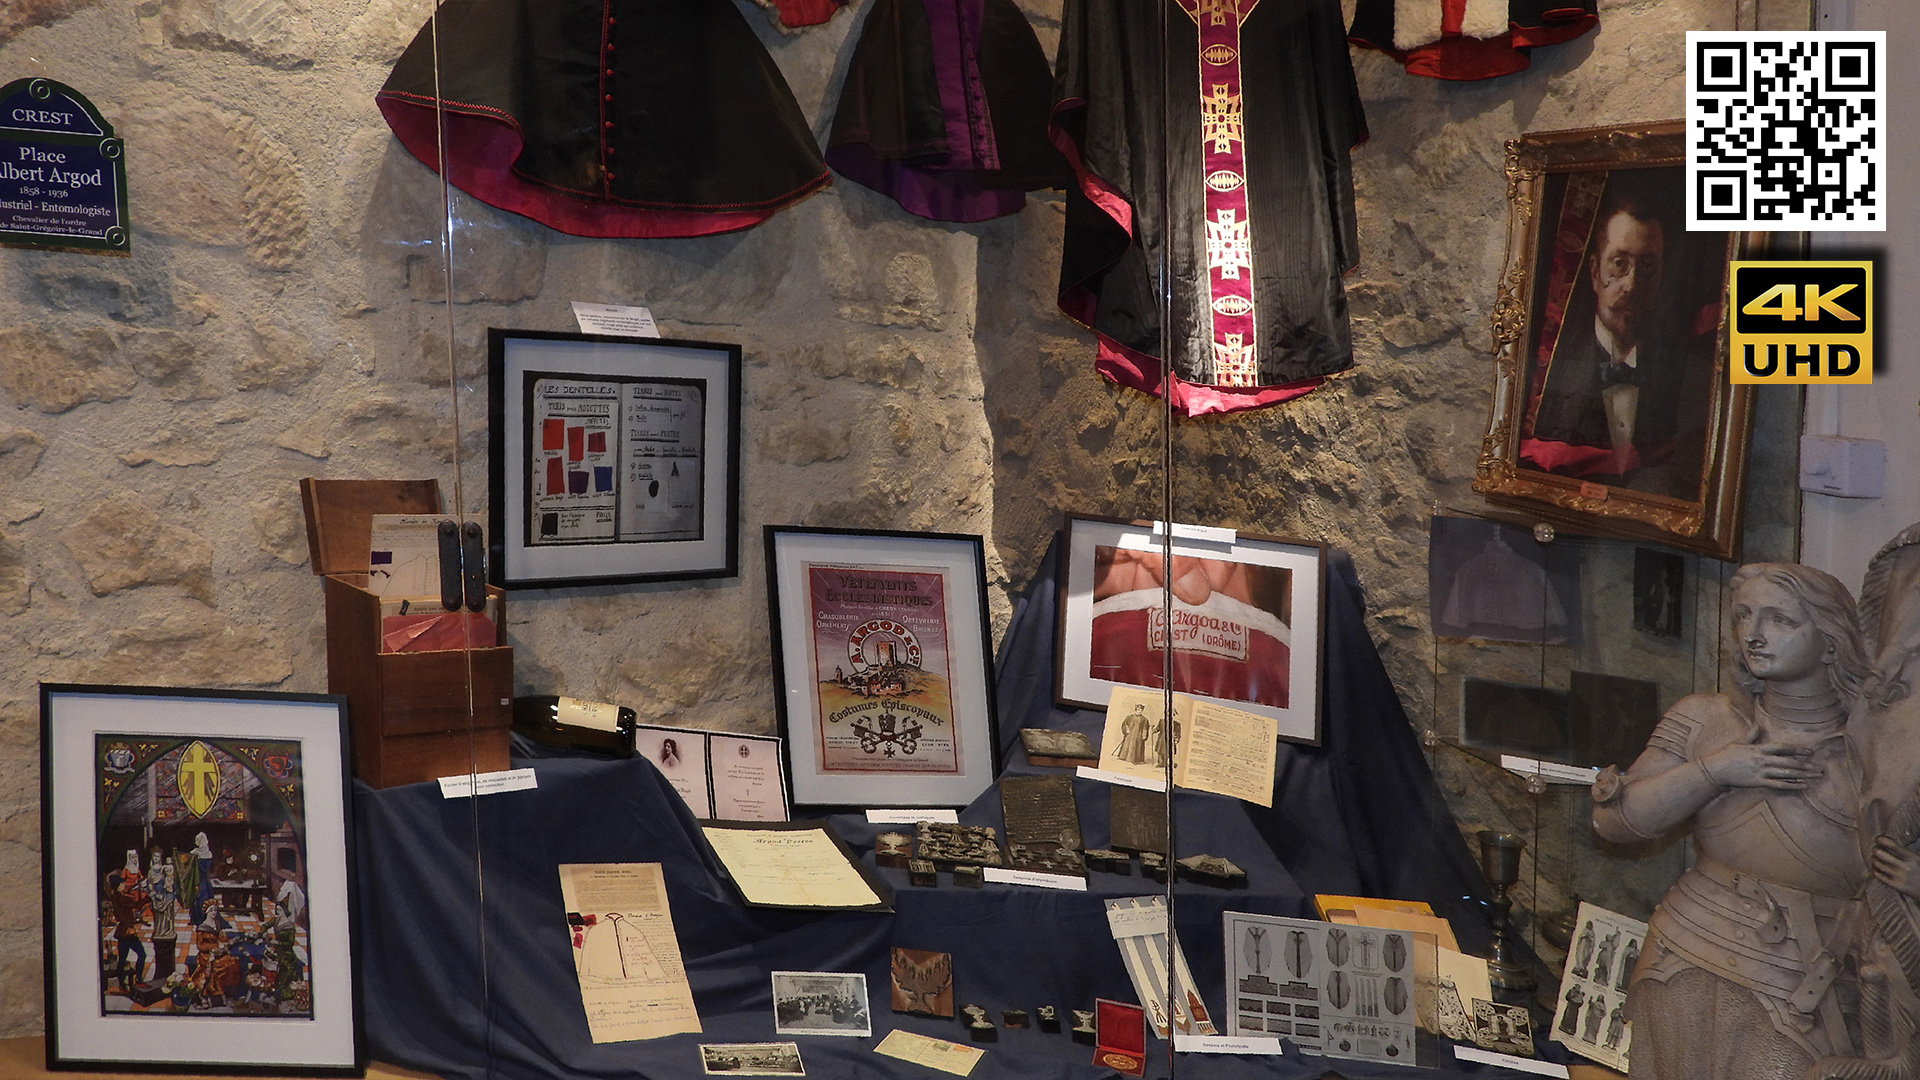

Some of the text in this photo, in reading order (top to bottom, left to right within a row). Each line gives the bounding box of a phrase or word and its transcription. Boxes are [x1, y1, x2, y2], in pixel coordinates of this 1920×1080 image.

[12, 108, 73, 125] CREST
[19, 147, 66, 164] Place
[49, 167, 102, 188] Argod
[19, 186, 40, 196] 1858
[48, 189, 68, 198] 1936
[41, 201, 111, 217] Entomologiste
[12, 215, 49, 224] Chevalier
[851, 620, 905, 646] ARGOD
[1202, 633, 1241, 651] (DRÔME)
[829, 700, 878, 723] Costumes
